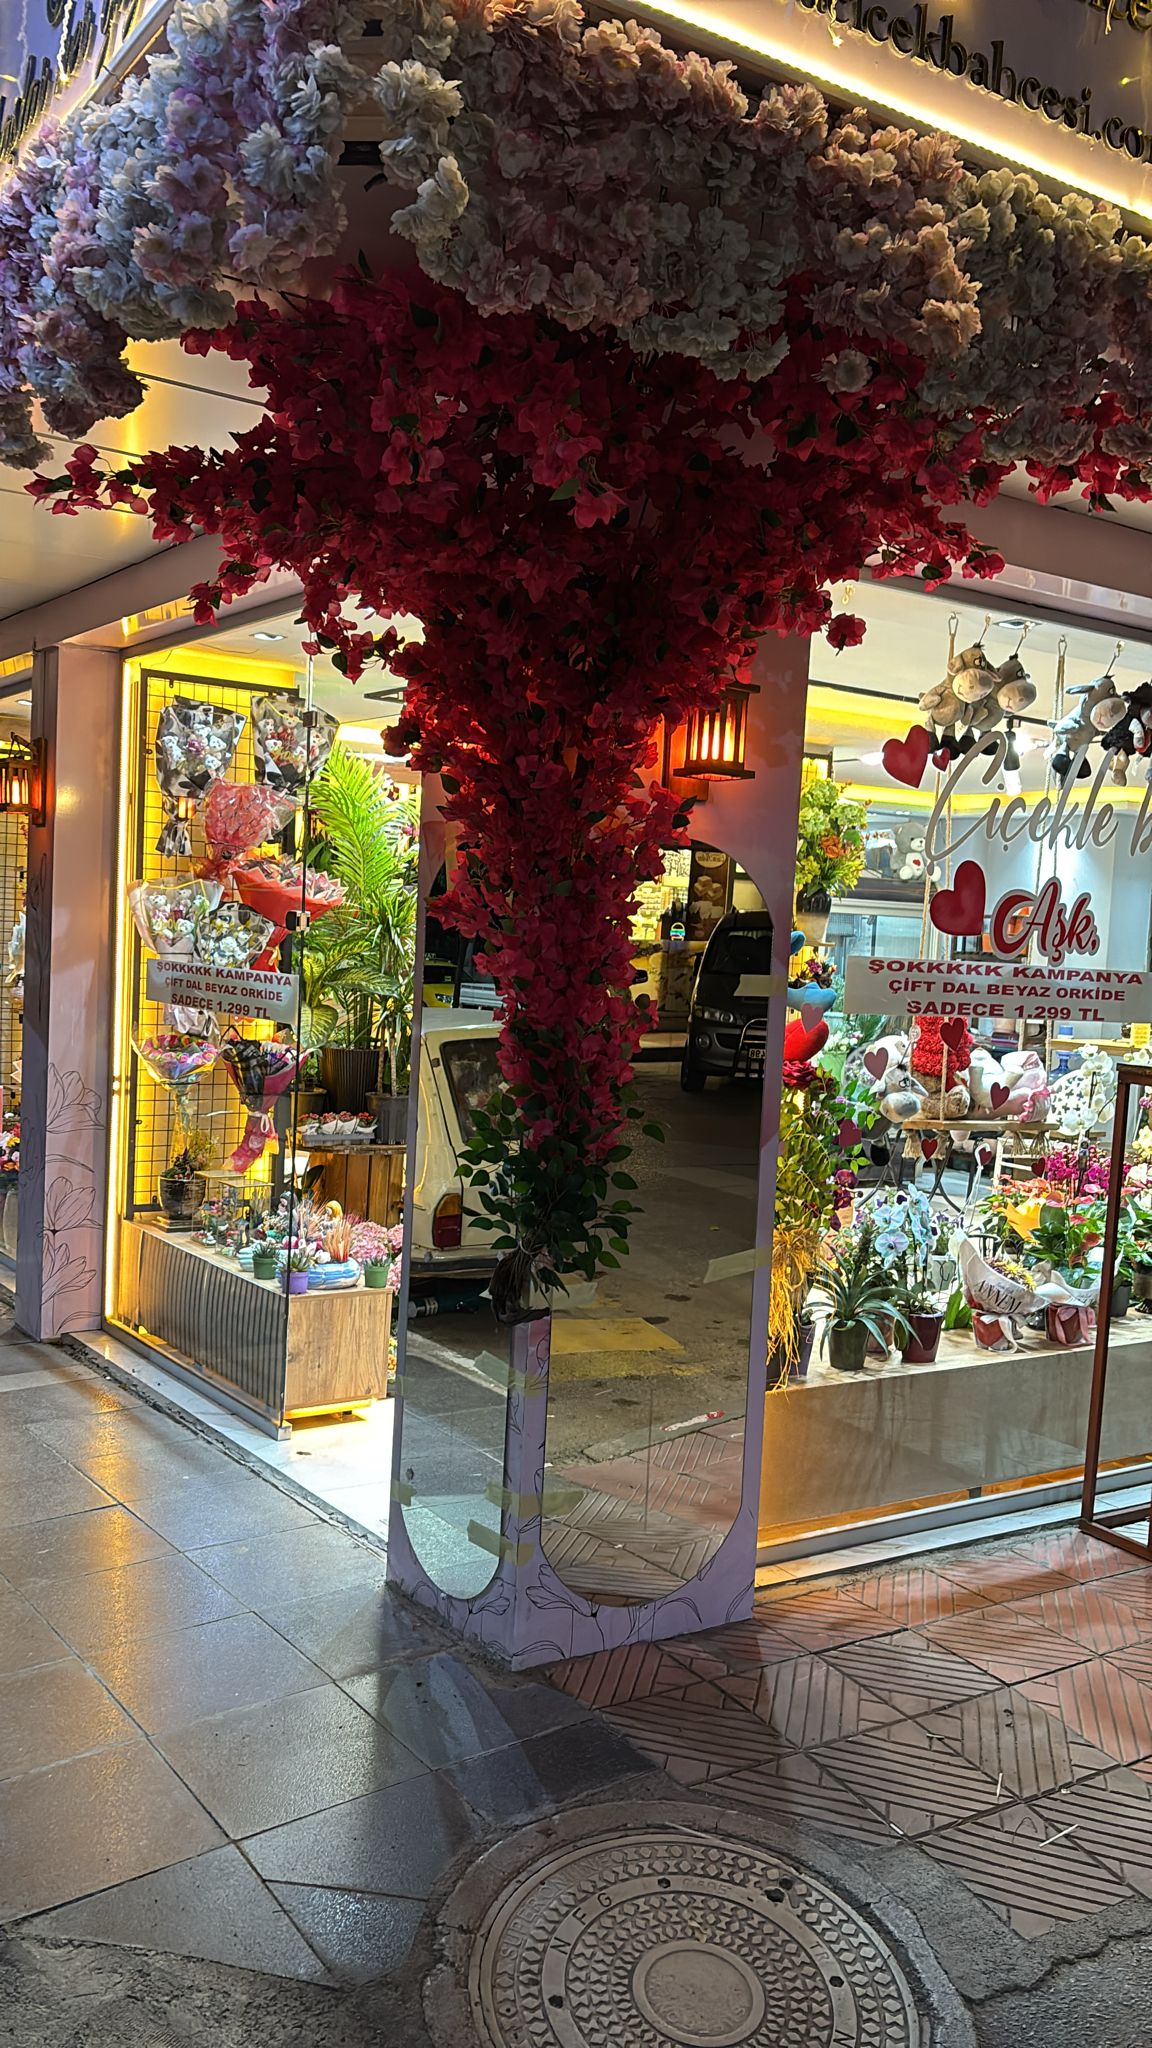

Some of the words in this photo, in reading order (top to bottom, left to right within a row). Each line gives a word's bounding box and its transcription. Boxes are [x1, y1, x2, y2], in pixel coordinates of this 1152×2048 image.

[925, 730, 1119, 876] Çiçekle
[156, 961, 212, 977] ŞOKKKKK
[216, 968, 292, 987] KAMPANYA
[868, 959, 1003, 977] ŞOKKKKK
[1012, 966, 1143, 985] KAMPANYA
[165, 976, 184, 988] ÇİFT
[186, 980, 202, 990] DAL
[205, 982, 237, 995] BEYAZ
[241, 987, 283, 1002] ORKİDE
[888, 978, 936, 994] ÇİFT
[942, 982, 980, 994] DAL
[987, 983, 1051, 998] BEYAZ
[1056, 986, 1126, 1001] ORKİDE
[171, 993, 213, 1010] SADECE
[217, 1001, 250, 1016] 1.299
[254, 1007, 271, 1019] TL
[906, 1000, 1005, 1017] SADECE
[1014, 1005, 1071, 1020] 1.299
[1079, 1008, 1105, 1022] TL
